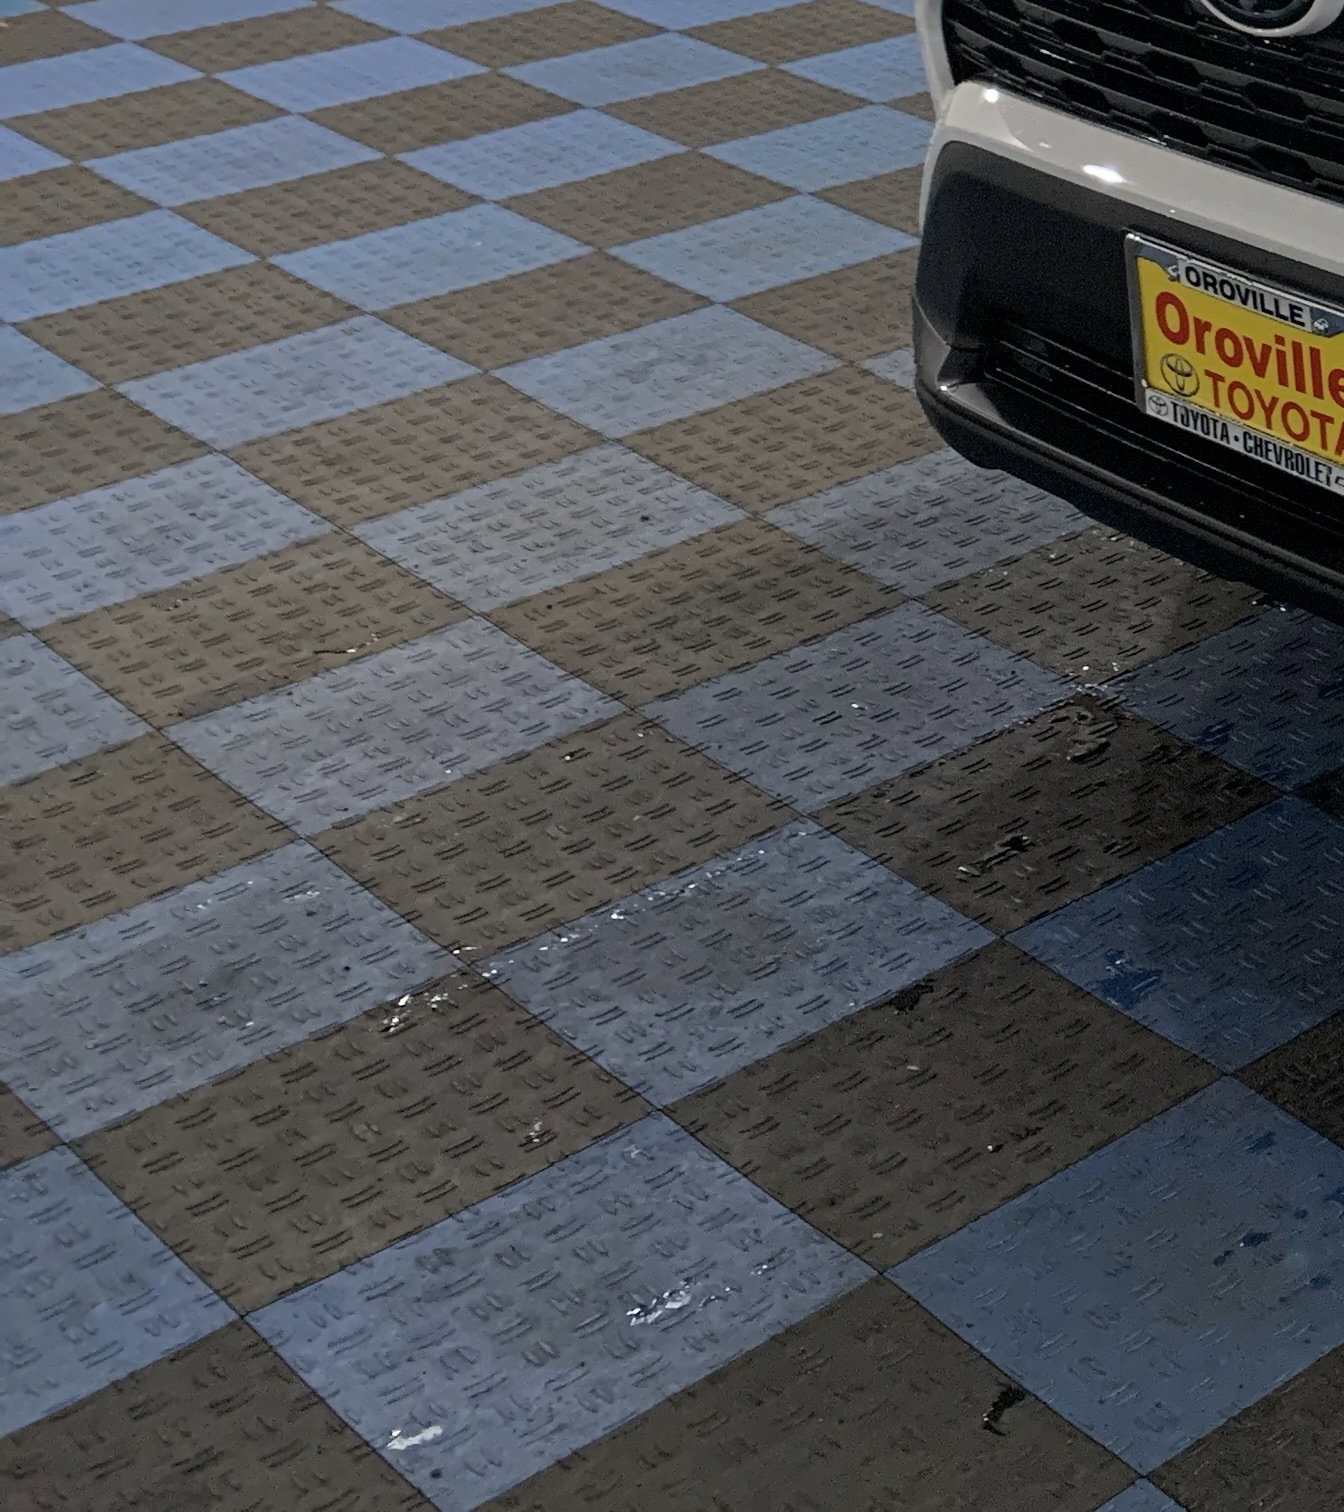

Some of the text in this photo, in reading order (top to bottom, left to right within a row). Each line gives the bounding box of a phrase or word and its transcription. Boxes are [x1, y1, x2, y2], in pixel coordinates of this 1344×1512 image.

[1184, 266, 1306, 328] OROVILLE
[1171, 401, 1335, 487] TOYOTA CHEVROLET
